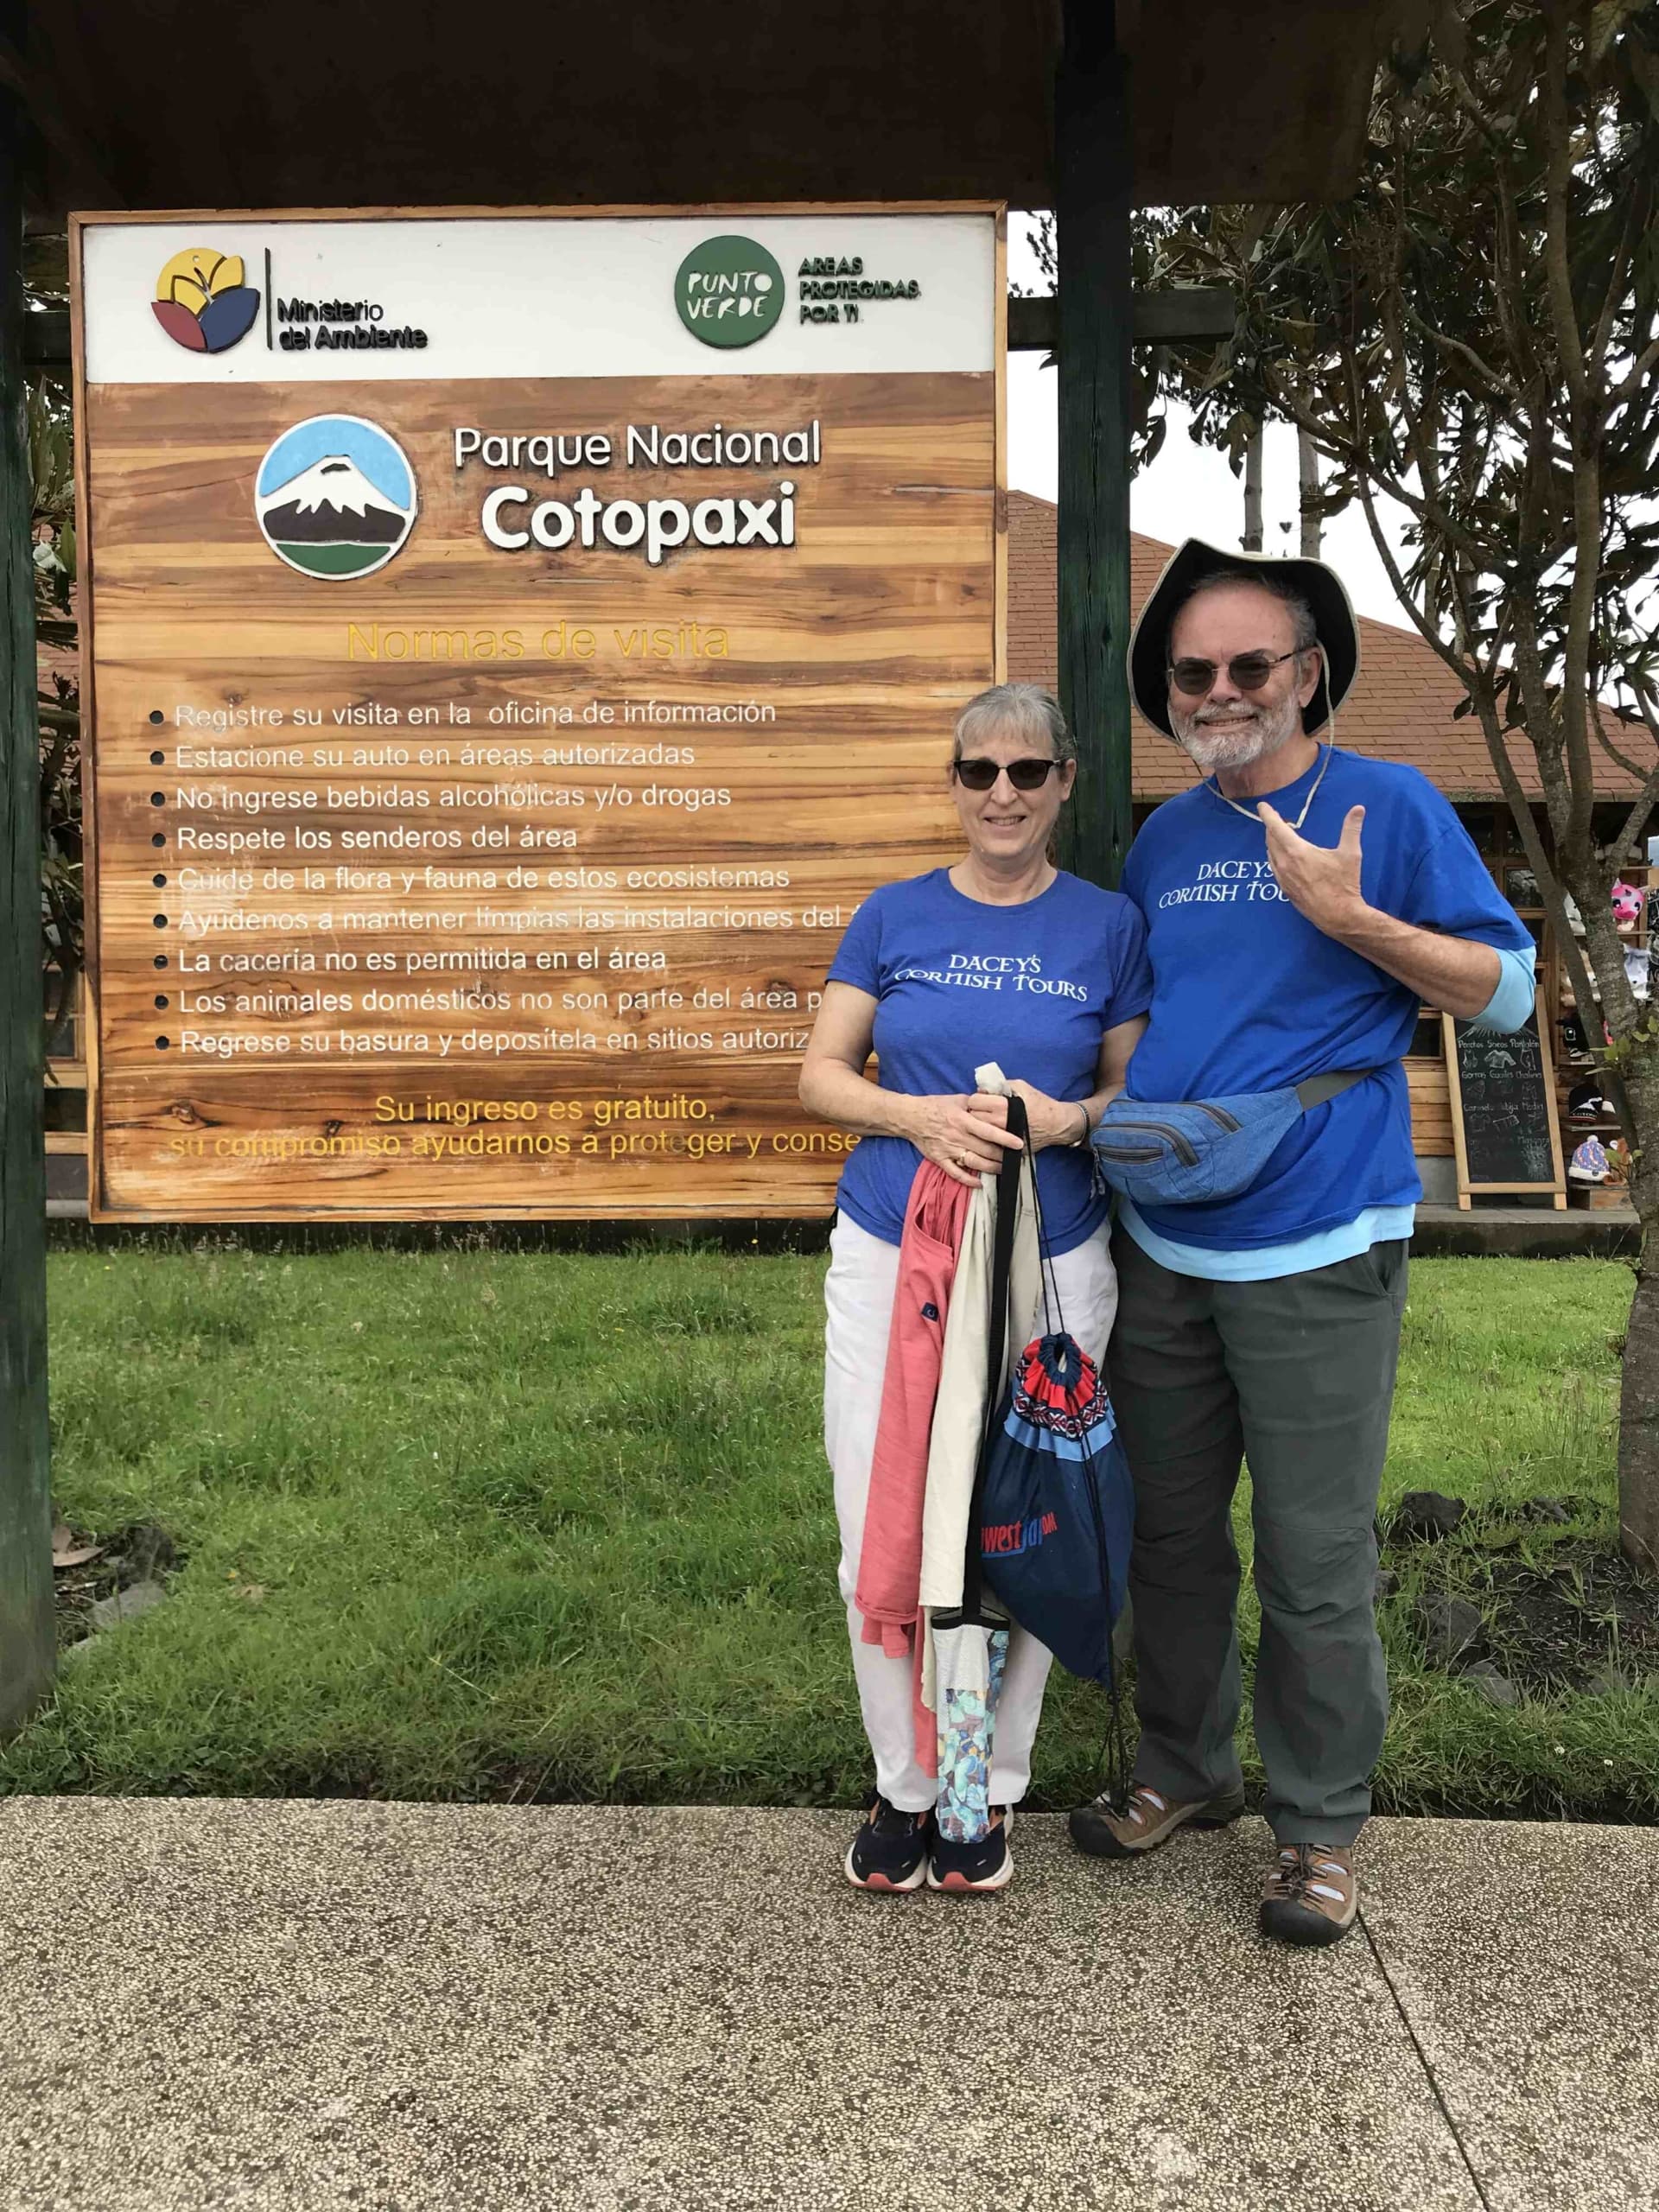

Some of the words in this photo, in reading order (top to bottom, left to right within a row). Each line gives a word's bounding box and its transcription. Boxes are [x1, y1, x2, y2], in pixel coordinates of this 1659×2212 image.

[798, 256, 863, 276] AREAS
[688, 271, 772, 291] PUNTO
[277, 298, 384, 323] Ministerio
[686, 295, 766, 320] VERDE
[800, 303, 839, 325] POR
[279, 327, 311, 350] del
[315, 326, 429, 350] Ambiente
[454, 429, 611, 478] Parque
[626, 419, 821, 467] Nacional
[481, 480, 797, 566] Cotopaxi
[347, 622, 525, 661] Normas
[541, 620, 596, 659] de
[613, 620, 729, 659] visita
[175, 704, 283, 733] Registre
[293, 709, 322, 726] su
[332, 703, 398, 725] visita
[408, 708, 439, 725] en
[448, 702, 471, 725] la
[488, 701, 574, 725] oficina
[582, 701, 615, 723] de
[624, 699, 776, 723] información
[175, 745, 303, 769] Estacione
[313, 749, 343, 767] su
[353, 746, 410, 766] auto
[419, 747, 449, 766] en
[460, 743, 532, 766] áreas
[543, 742, 695, 766] autorizadas
[176, 788, 213, 810] No
[222, 786, 318, 815] ingrese
[327, 785, 430, 808] bebidas
[439, 783, 585, 808] alcohólicas
[594, 783, 632, 812] y/o
[641, 784, 732, 812] drogas
[177, 826, 286, 855] Respete
[295, 825, 333, 849] los
[340, 825, 462, 849] senderos
[471, 825, 510, 848] del
[518, 824, 577, 848] área
[178, 868, 253, 891] Cuide
[263, 867, 296, 890] de
[304, 867, 326, 889] la
[335, 866, 391, 889] flora
[402, 872, 415, 893] y
[424, 866, 497, 889] fauna
[505, 865, 538, 888] de
[548, 867, 618, 888] estos
[626, 865, 790, 887] ecosistemas
[1159, 884, 1239, 909] CORNISH
[1247, 881, 1290, 902] TOU
[178, 907, 308, 937] Ayúdenos
[317, 912, 334, 930] a
[343, 908, 465, 929] mantener
[578, 906, 615, 929] las
[624, 905, 794, 928] instalaciones
[802, 904, 841, 928] del
[179, 949, 210, 972] La
[219, 948, 315, 972] cacería
[325, 952, 357, 971] no
[365, 951, 397, 971] es
[406, 947, 526, 975] permitida
[536, 950, 568, 969] en
[576, 947, 600, 969] el
[608, 947, 666, 969] área
[894, 969, 1002, 990] CORNISH
[1013, 974, 1088, 1001] TOURS
[180, 990, 226, 1013] Los
[236, 988, 353, 1013] animales
[361, 988, 511, 1012] domésticos
[520, 991, 553, 1010] no
[562, 990, 607, 1010] son
[618, 988, 683, 1014] parte
[693, 988, 729, 1009] del
[740, 986, 798, 1009] área
[181, 1030, 290, 1058] Regrese
[300, 1034, 330, 1052] su
[340, 1029, 429, 1052] basura
[439, 1033, 453, 1056] y
[461, 1027, 596, 1056] deposítela
[607, 1031, 638, 1050] en
[646, 1027, 713, 1049] sitios
[722, 1027, 809, 1048] autoriz
[374, 1096, 415, 1122] Su
[426, 1095, 537, 1127] ingreso
[548, 1099, 583, 1120] es
[594, 1093, 715, 1126] gratuito,
[171, 1135, 204, 1156] su
[214, 1130, 401, 1160] compromiso
[412, 1129, 570, 1160] ayudarnos
[582, 1134, 598, 1153] a
[610, 1132, 737, 1160] proteger
[747, 1133, 762, 1159] y
[772, 1132, 861, 1153] conse
